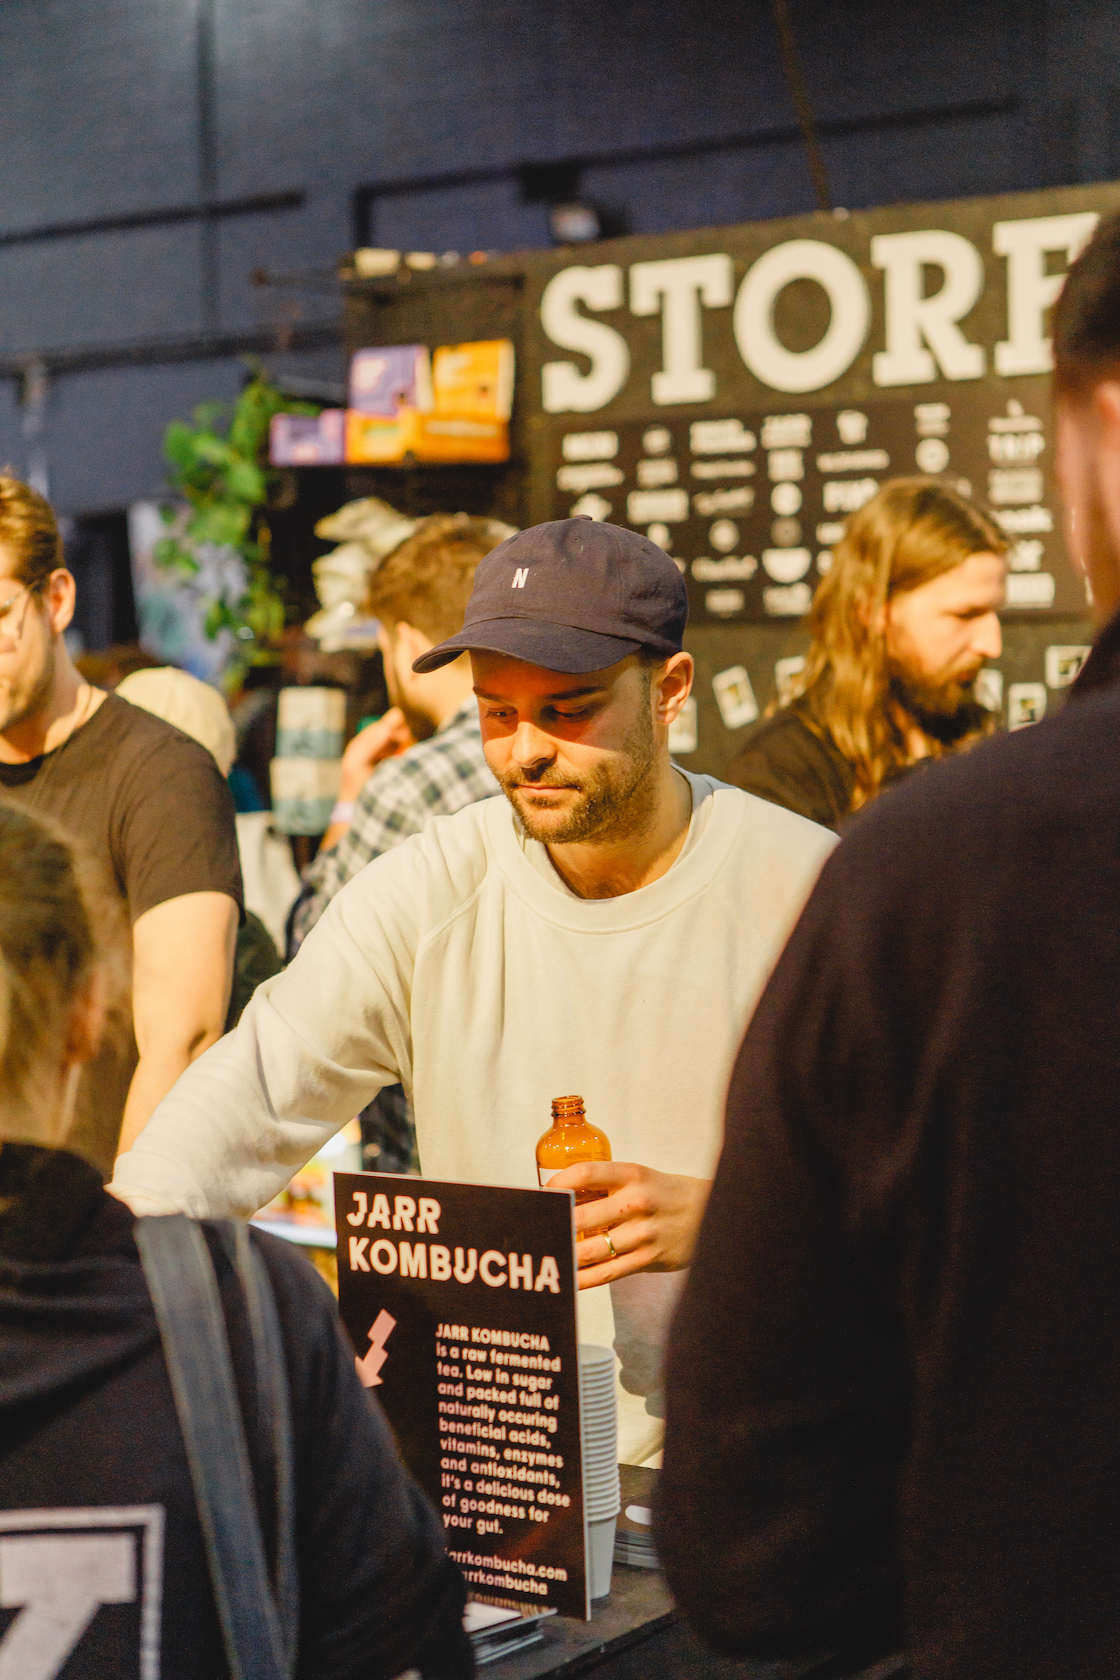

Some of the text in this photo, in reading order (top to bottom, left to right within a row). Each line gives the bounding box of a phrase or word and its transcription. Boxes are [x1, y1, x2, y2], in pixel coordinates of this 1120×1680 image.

[511, 567, 530, 589] N
[346, 1191, 441, 1234] JARR
[348, 1236, 560, 1294] KOMBUCHA
[435, 1323, 550, 1352] JARR KOMBUCHA
[435, 1341, 562, 1372] is a raw fermented
[436, 1360, 553, 1392] tea. Low in sugar
[437, 1382, 560, 1411] and packed full of
[438, 1400, 558, 1433] naturally occuring
[438, 1417, 552, 1449] beneficial acids,
[440, 1436, 564, 1468] vitamins, enzymes
[440, 1457, 561, 1489] and antioxidants,
[441, 1472, 571, 1507] it's a delicious dose
[441, 1493, 550, 1523] of goodness for
[442, 1513, 504, 1535] your gut.
[444, 1547, 568, 1582] arrkombucha.com
